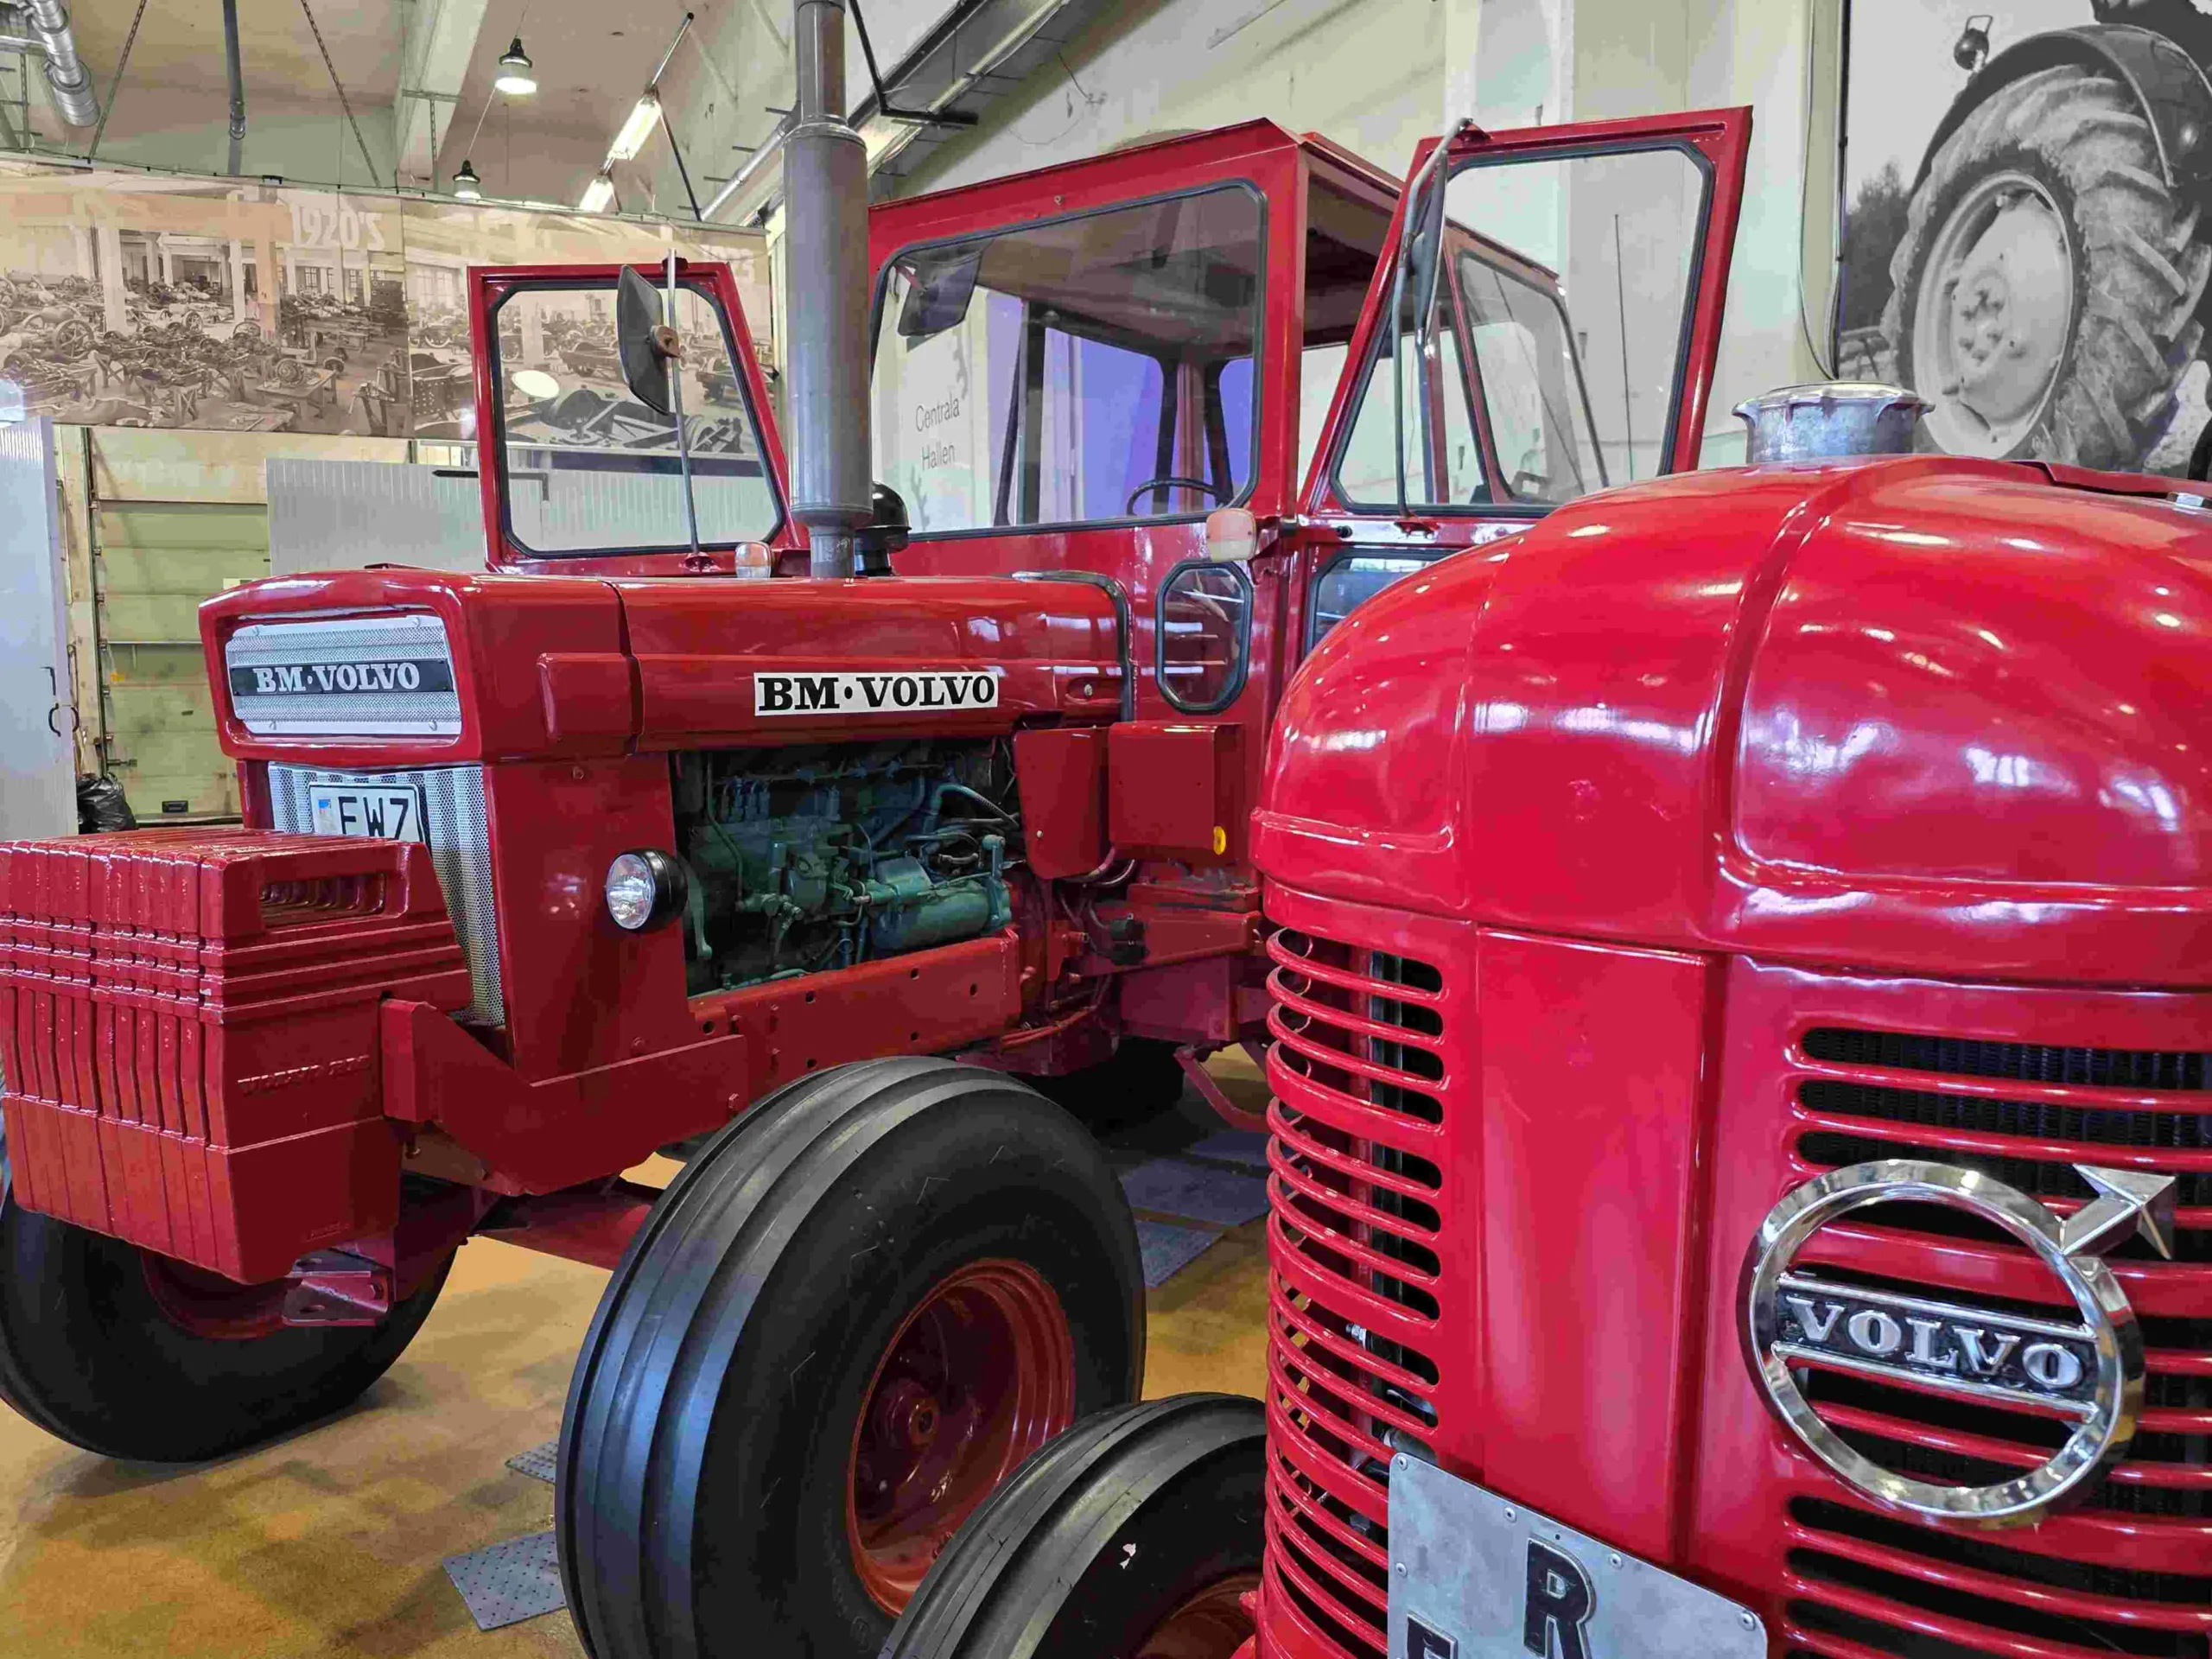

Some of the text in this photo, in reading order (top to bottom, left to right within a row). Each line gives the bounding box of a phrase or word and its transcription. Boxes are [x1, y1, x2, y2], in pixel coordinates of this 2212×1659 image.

[916, 391, 960, 432] Centrala
[921, 440, 956, 471] Hallen
[1785, 1294, 2083, 1389] VOLVO
